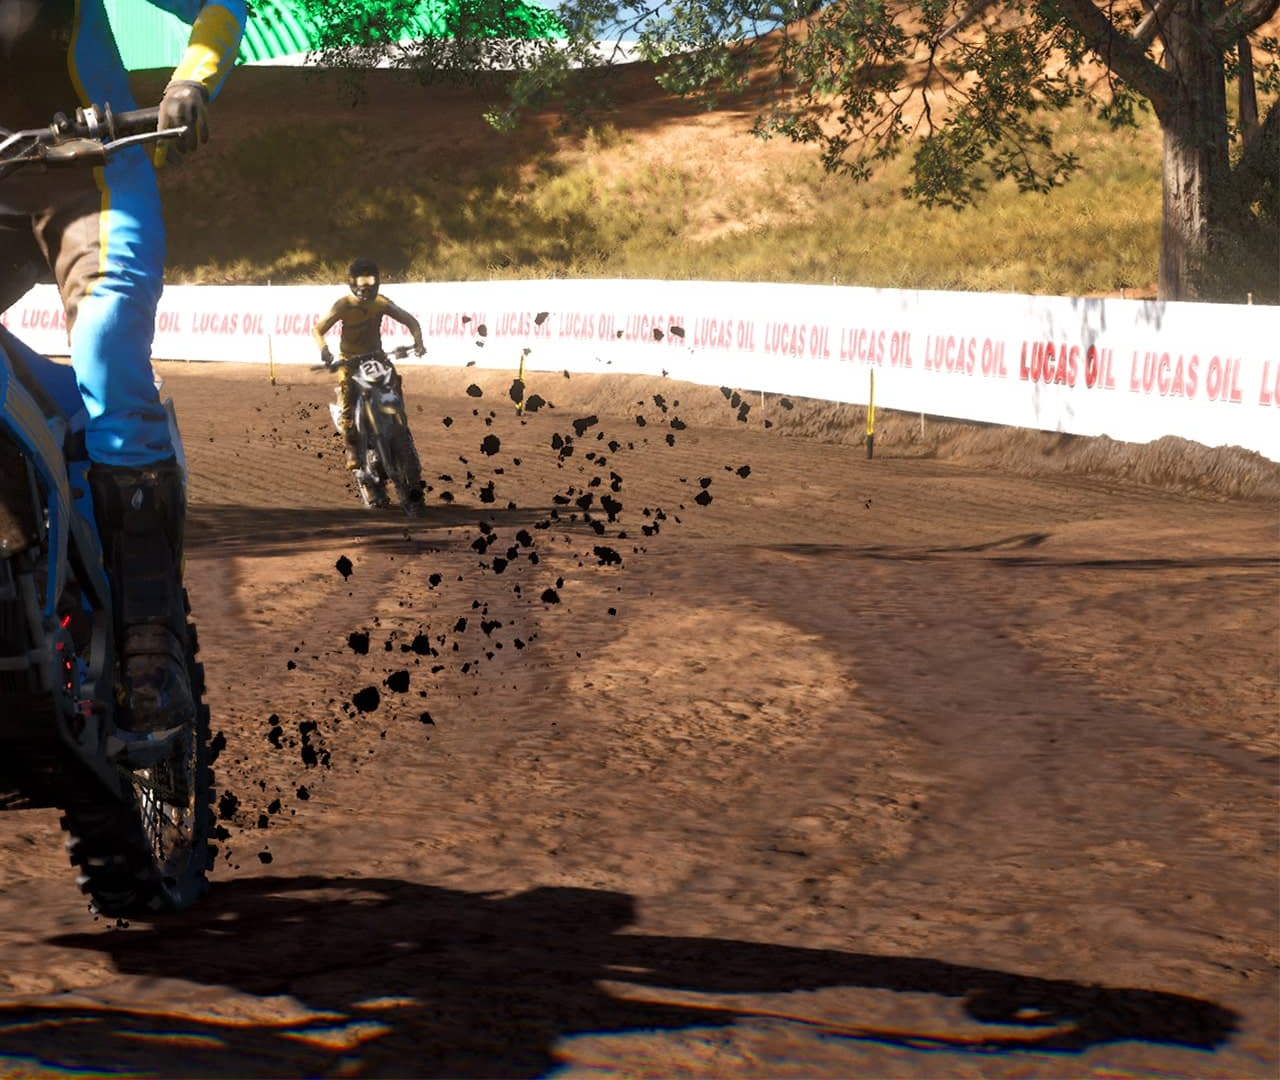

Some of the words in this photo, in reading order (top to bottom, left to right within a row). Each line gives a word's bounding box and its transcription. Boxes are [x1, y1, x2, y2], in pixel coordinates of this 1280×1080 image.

[159, 311, 181, 333] OIL
[192, 312, 238, 334] LUCAS
[242, 312, 264, 335] OIL
[496, 311, 531, 336] LUCAS
[559, 311, 595, 338] LUCAS
[598, 313, 615, 340] OIL
[694, 318, 733, 350] LUCAS
[737, 320, 755, 352] OIL
[765, 323, 806, 356] LUCAS
[809, 322, 831, 359] OIL
[840, 328, 885, 365] LUCAS
[889, 331, 912, 368] OIL
[924, 335, 977, 374] LUCAS
[981, 338, 1007, 377] OIL
[363, 362, 380, 375] 21
[1020, 340, 1080, 388] LUCAS
[1084, 344, 1116, 390] OIL
[1129, 351, 1200, 399] LUCAS
[1206, 355, 1242, 403] OIL
